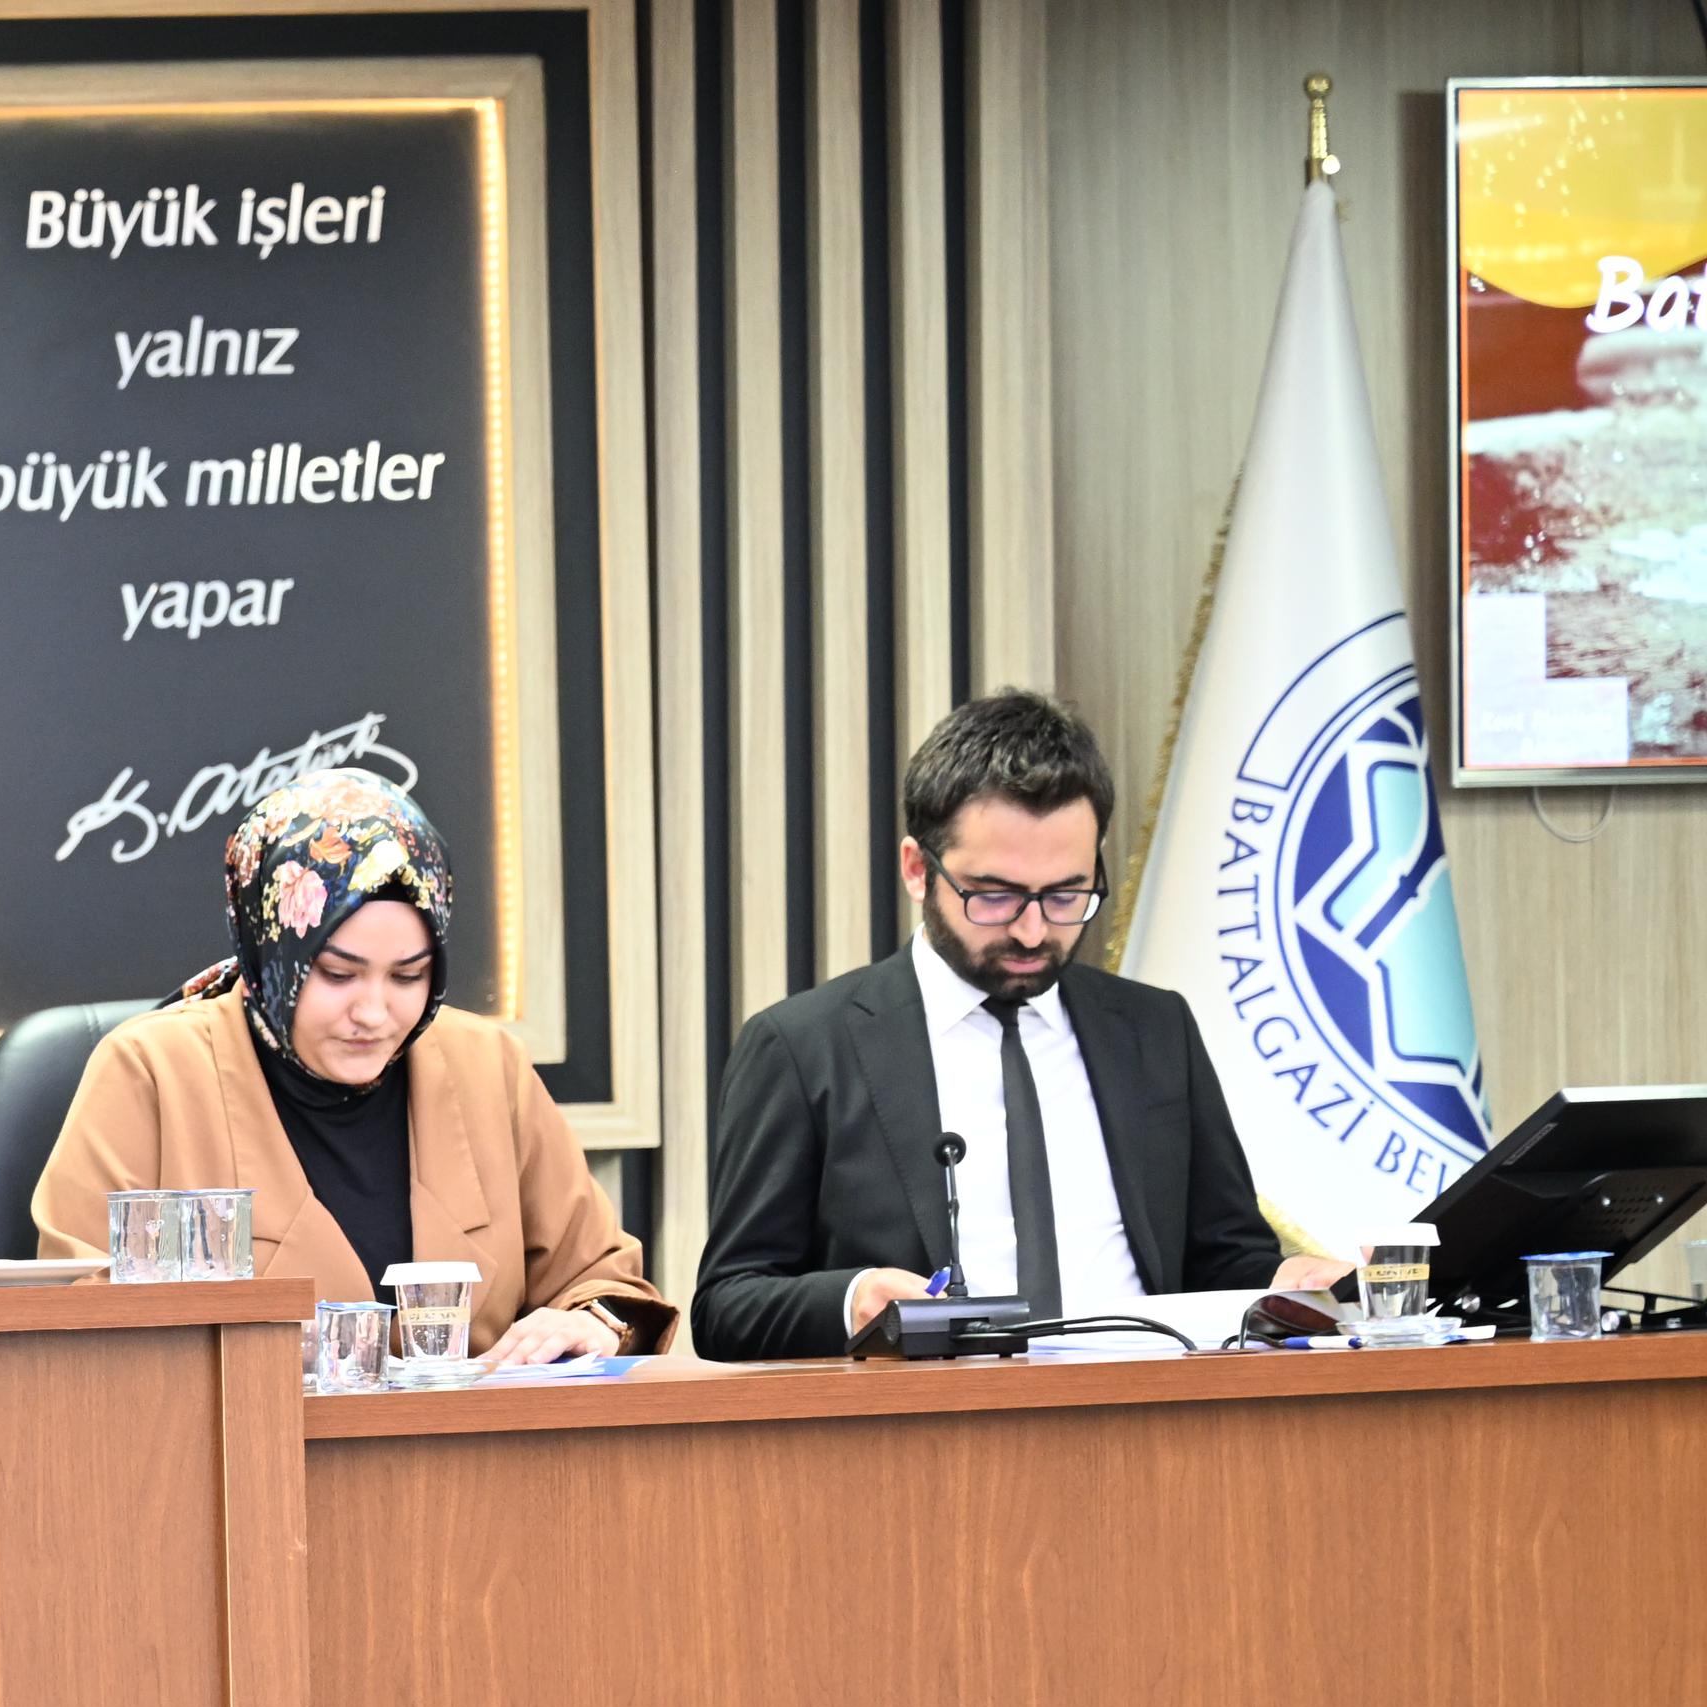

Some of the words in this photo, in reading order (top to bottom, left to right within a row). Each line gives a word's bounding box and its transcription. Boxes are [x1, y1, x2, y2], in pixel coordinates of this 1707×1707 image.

[25, 184, 218, 260] Büyük
[237, 182, 386, 260] işleri
[114, 315, 300, 390] yalnız
[185, 440, 446, 507] milletler
[120, 577, 295, 642] yapar
[1217, 796, 1376, 1143] BATTALGAZİ
